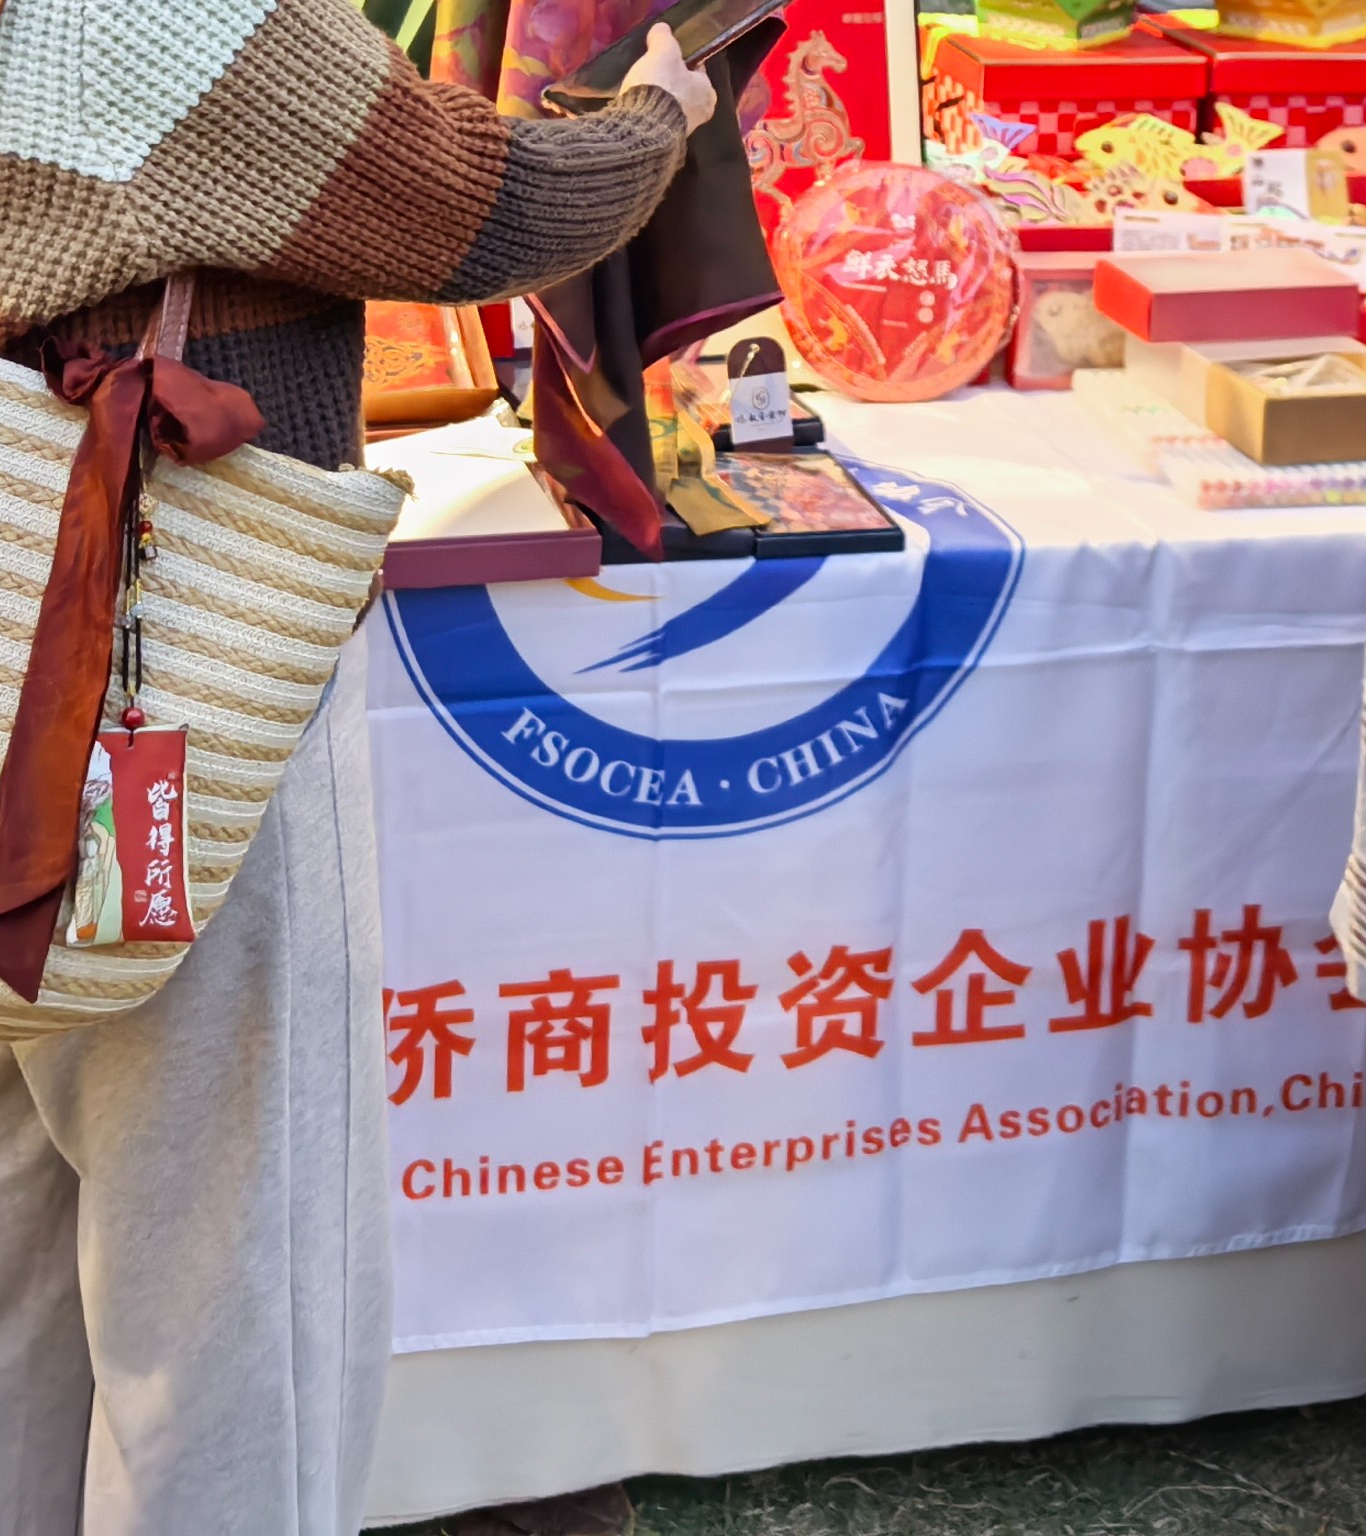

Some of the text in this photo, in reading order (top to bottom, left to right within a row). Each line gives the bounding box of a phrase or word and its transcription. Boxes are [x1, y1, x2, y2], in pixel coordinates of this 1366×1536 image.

[501, 691, 910, 806] FSOCEA CHINA
[401, 1154, 625, 1201] Chinese
[643, 1116, 942, 1187] Enterprises
